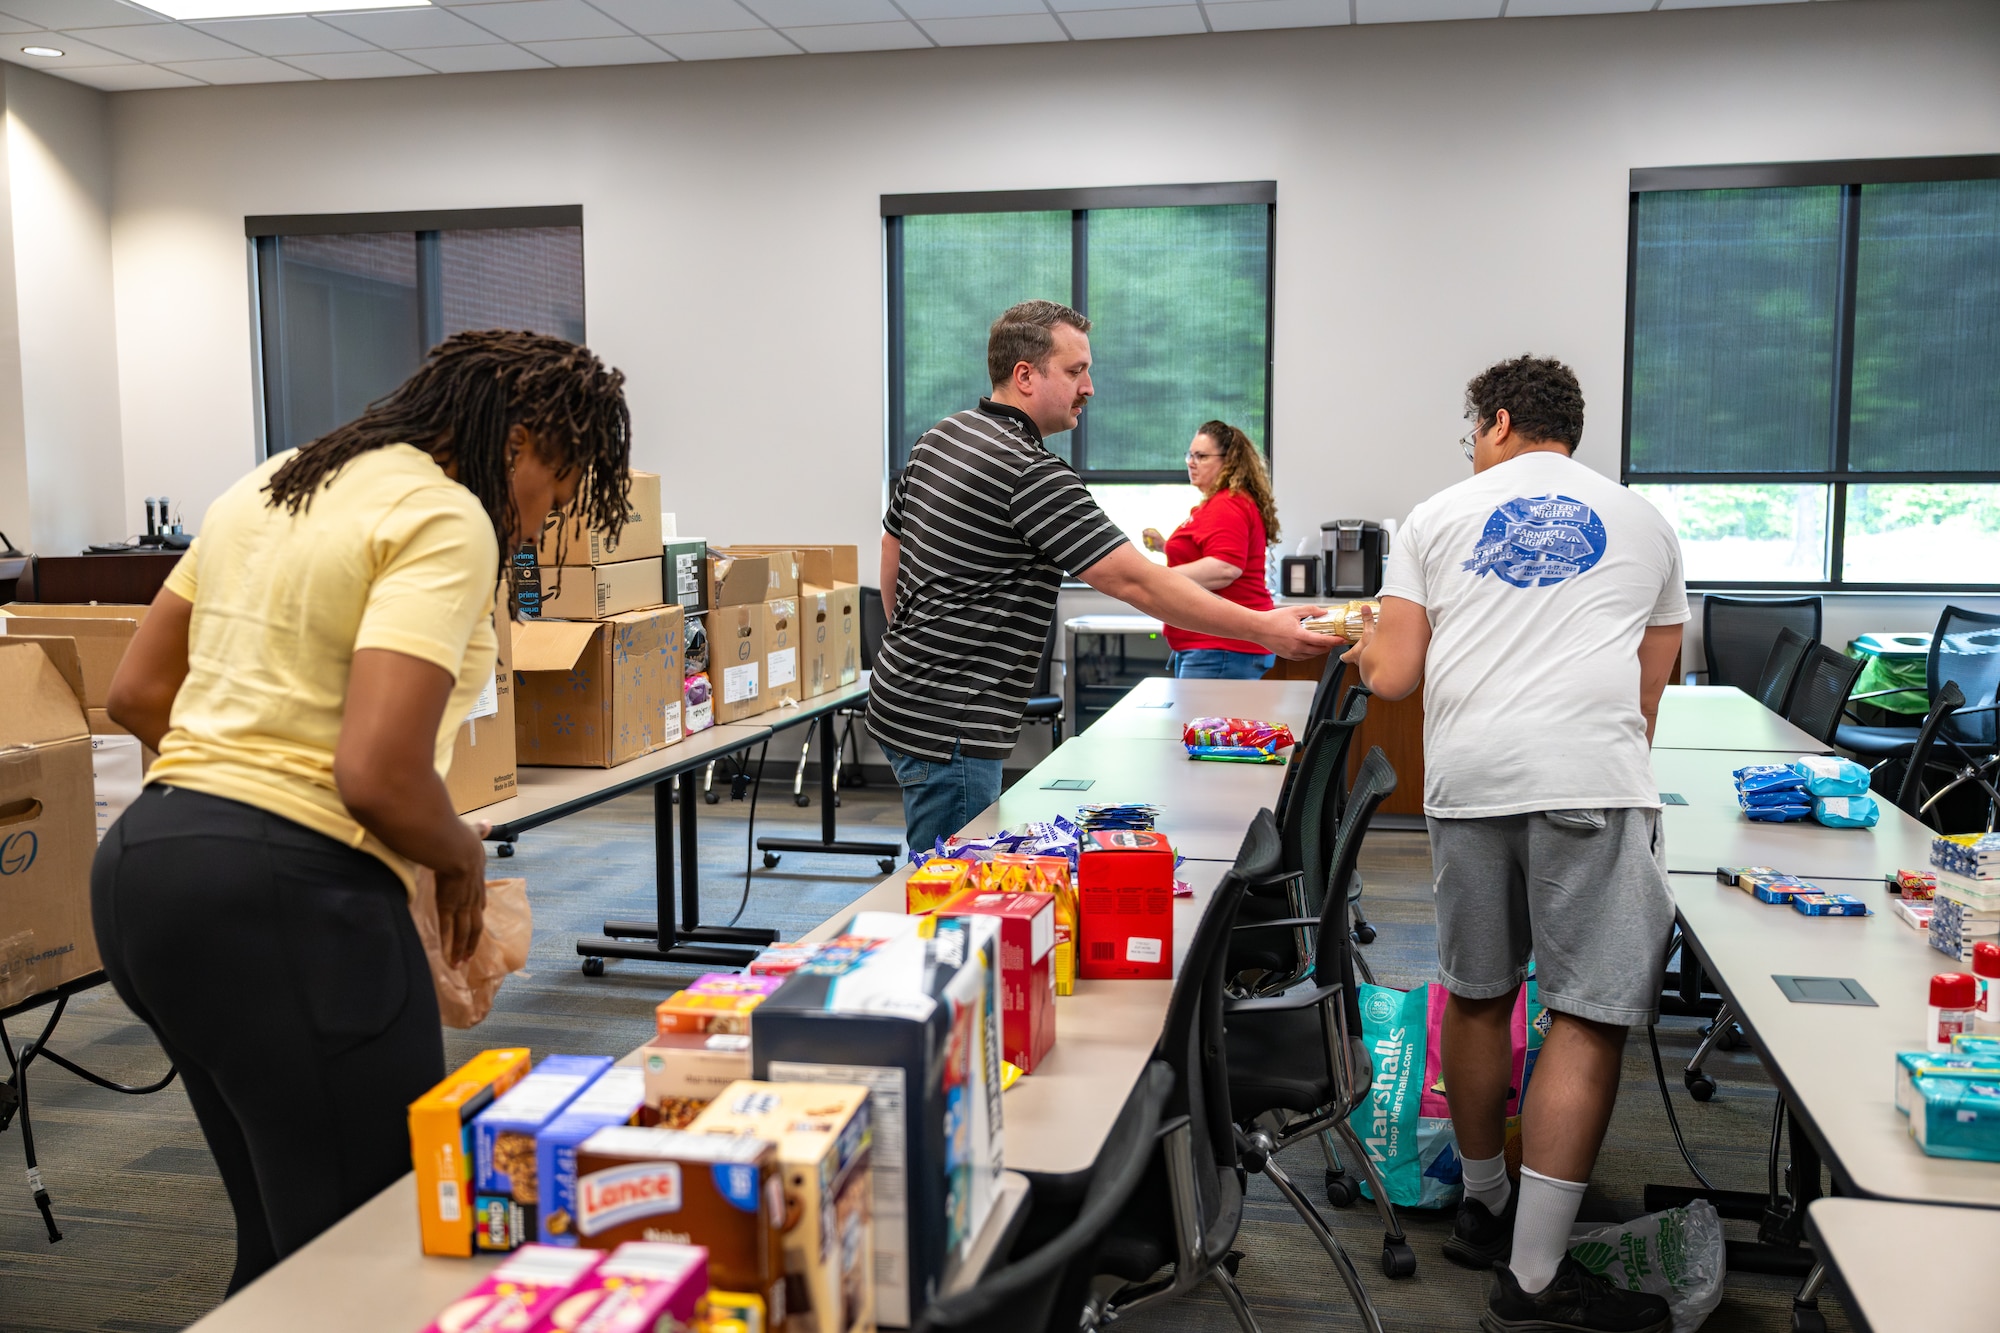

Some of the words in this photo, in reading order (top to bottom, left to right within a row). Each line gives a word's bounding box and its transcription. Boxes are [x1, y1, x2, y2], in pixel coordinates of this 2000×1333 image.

[1529, 502, 1581, 513] WESTERN
[1534, 510, 1575, 518] NIGHTS
[1513, 527, 1567, 540] CARNIVAL
[1519, 537, 1556, 547] LIGHTS
[513, 552, 535, 561] prime
[1473, 545, 1504, 560] FAIR
[518, 590, 539, 600] prime
[1904, 877, 1922, 888] UNO
[1390, 1043, 1414, 1125] Marshalls.com
[1365, 1025, 1406, 1179] Marshalls
[1429, 1121, 1455, 1131] SWIS
[1388, 1126, 1400, 1158] Shop
[585, 1173, 671, 1214] Lance
[489, 1201, 505, 1244] KIND
[1633, 1236, 1652, 1278] TREE
